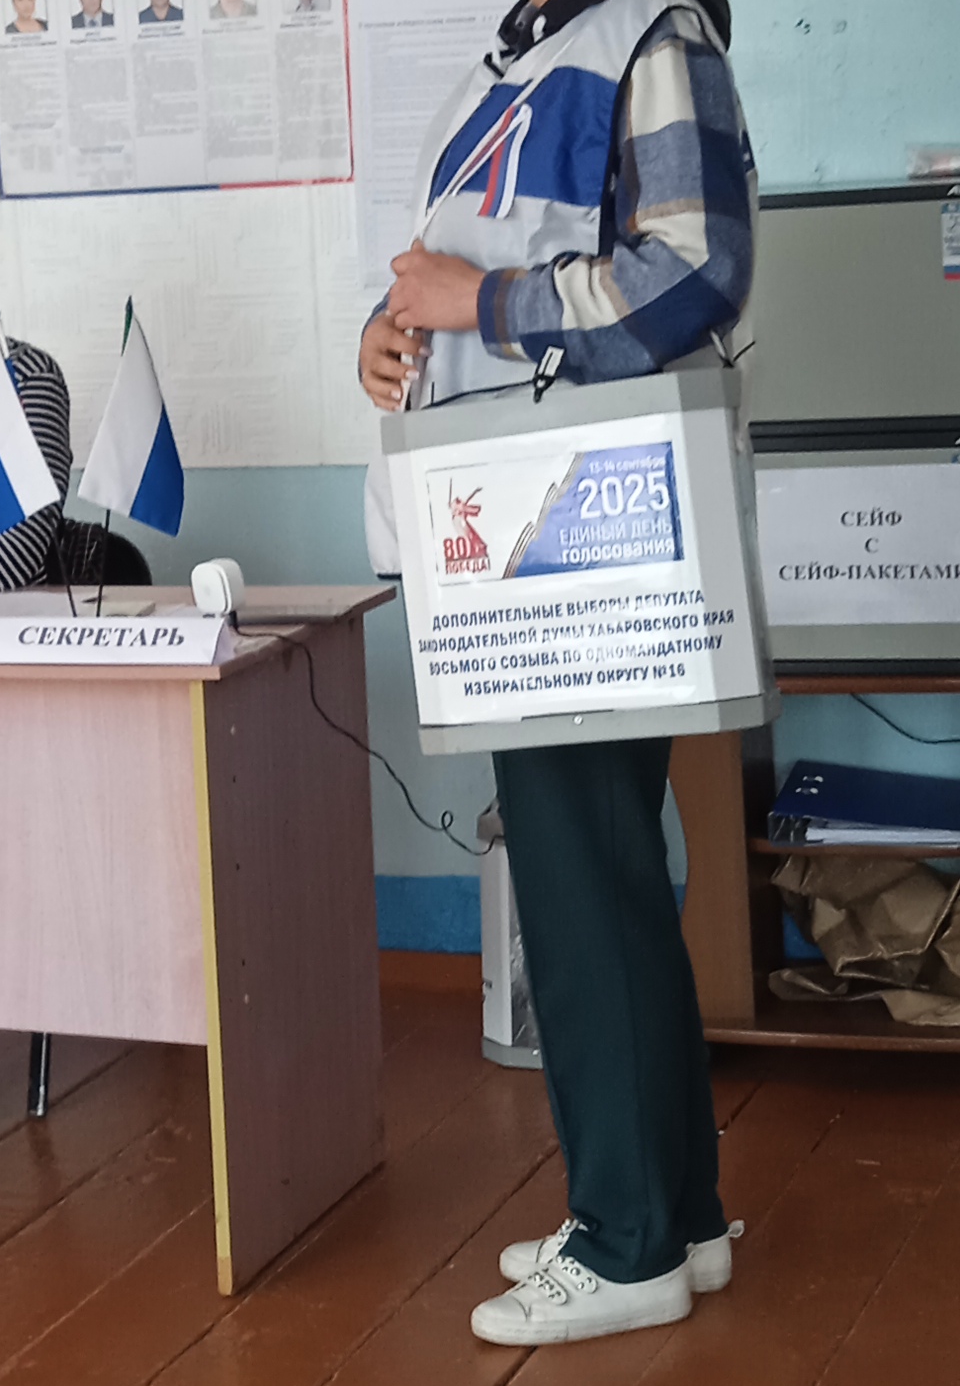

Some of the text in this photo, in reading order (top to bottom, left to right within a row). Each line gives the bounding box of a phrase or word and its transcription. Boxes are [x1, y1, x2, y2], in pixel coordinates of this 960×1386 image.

[577, 471, 670, 520] 2025
[559, 517, 673, 545] ЕДИНЫЙ ДЕНЬ
[840, 506, 902, 528] СЕЙФ
[443, 536, 471, 560] 80
[562, 537, 676, 565] голосования
[864, 537, 879, 554] С
[432, 589, 705, 631] ДОПОЛНИТЕЛЬНЫЕ ВЫБОРЫ ДЕПУТАТА
[18, 625, 185, 648] СЕКРЕТАРЬ
[541, 624, 584, 644] ДУМЫ
[588, 615, 698, 638] ХАБАРОВСКОГО
[703, 609, 735, 627] КРАЯ
[500, 650, 559, 670] СОЗЫВА
[563, 649, 581, 664] ПО
[586, 634, 723, 664] ОДНОМАНДАТНОМУ
[464, 670, 593, 697] ИЗБИРАТЕЛЬНОМУ
[596, 665, 649, 685] ОКРУГУ
